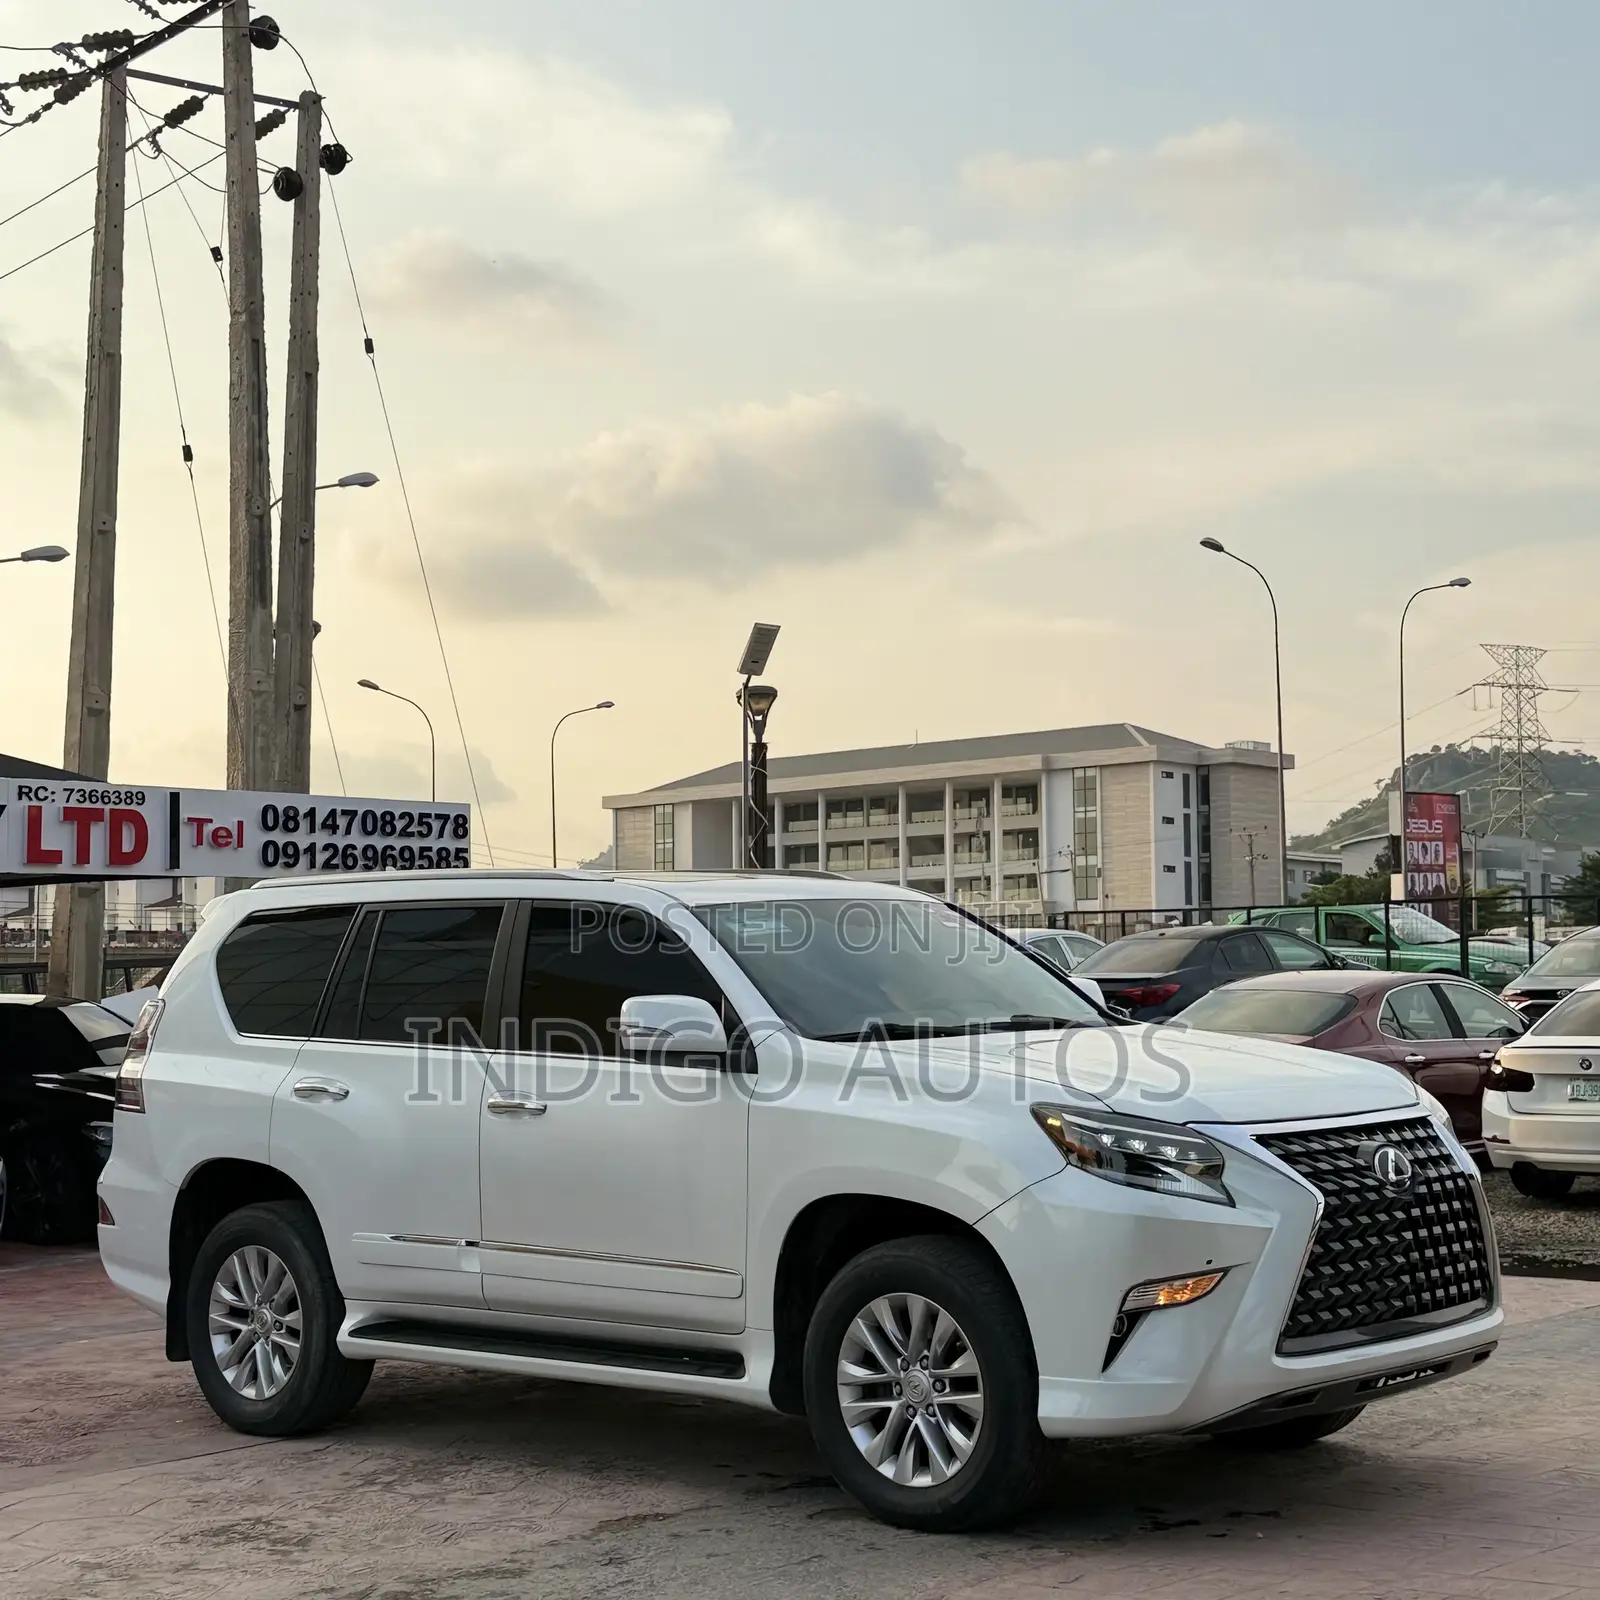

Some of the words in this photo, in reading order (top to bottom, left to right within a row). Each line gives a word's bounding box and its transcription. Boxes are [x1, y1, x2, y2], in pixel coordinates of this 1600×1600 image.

[18, 785, 56, 803] RC:
[62, 788, 146, 805] 7366389
[24, 805, 149, 866] LTD
[184, 816, 244, 849] Tel
[261, 804, 469, 839] 08147082578
[1406, 819, 1443, 833] JESUS
[261, 840, 469, 870] 09126969585
